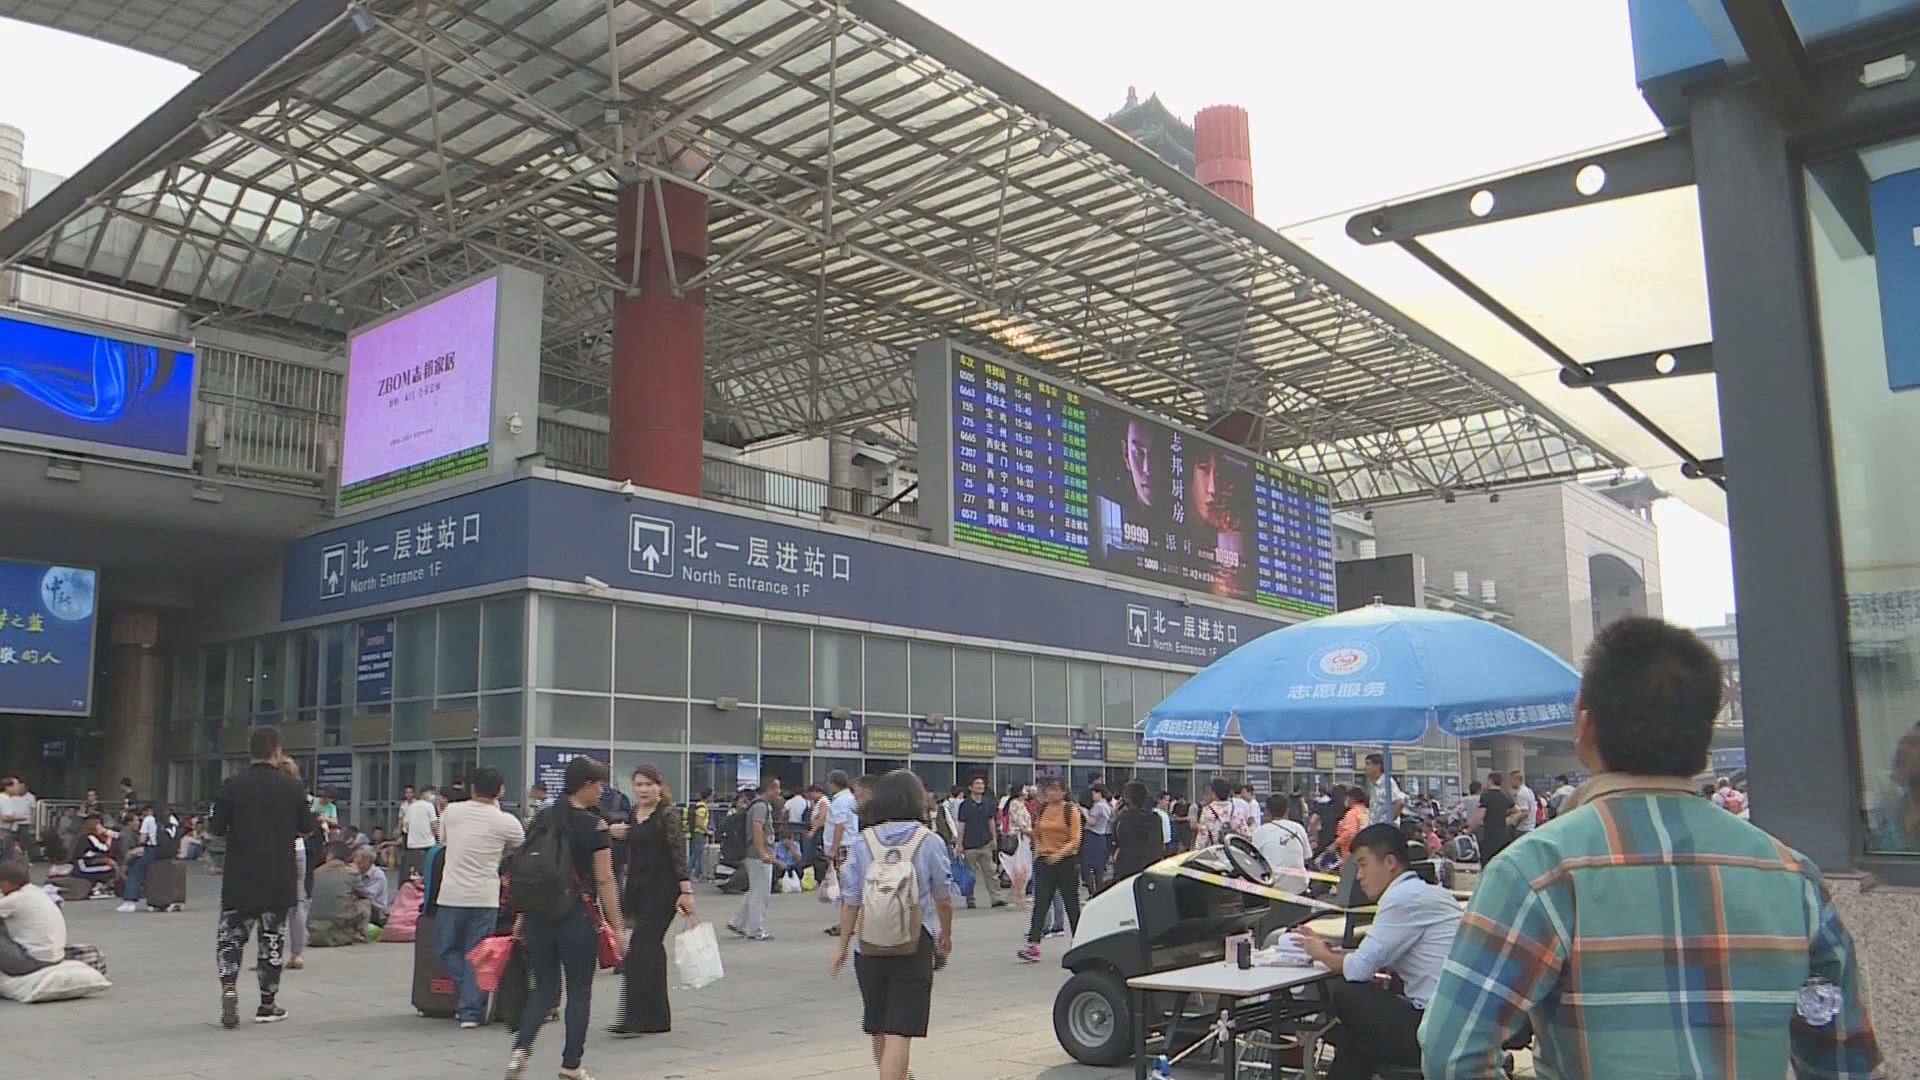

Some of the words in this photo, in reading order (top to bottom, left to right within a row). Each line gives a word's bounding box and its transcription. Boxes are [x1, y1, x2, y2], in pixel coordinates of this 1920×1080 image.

[985, 394, 1007, 409] 西安北
[986, 424, 1007, 438] 兰州
[1015, 433, 1033, 445] 15:57
[1015, 418, 1032, 430] 15:50
[986, 438, 1008, 453] 西安北
[1015, 447, 1033, 460] 16:00
[1016, 461, 1033, 474] 16:00
[1170, 431, 1184, 523] 志邦厨房
[987, 468, 1009, 483] 西宁
[1016, 476, 1034, 489] 16:03
[987, 483, 1009, 498] 南宁
[1016, 491, 1034, 504] 16:09
[1017, 506, 1034, 518] 16:15
[1049, 515, 1054, 523] 4
[351, 513, 481, 571] 北一层进站口
[1124, 523, 1149, 544] 9999
[683, 524, 851, 582] 北一层进站口
[350, 577, 376, 593] North
[379, 567, 425, 588] Entrance
[429, 561, 443, 577] 1F
[682, 566, 722, 586] North
[727, 573, 789, 596] Entrance
[795, 583, 811, 599] 1F
[1153, 610, 1238, 645] 北一层进站口
[1153, 639, 1173, 652] North
[1175, 642, 1207, 656] Entrance
[1209, 647, 1218, 657] 1F
[1287, 681, 1387, 700] 志愿服务
